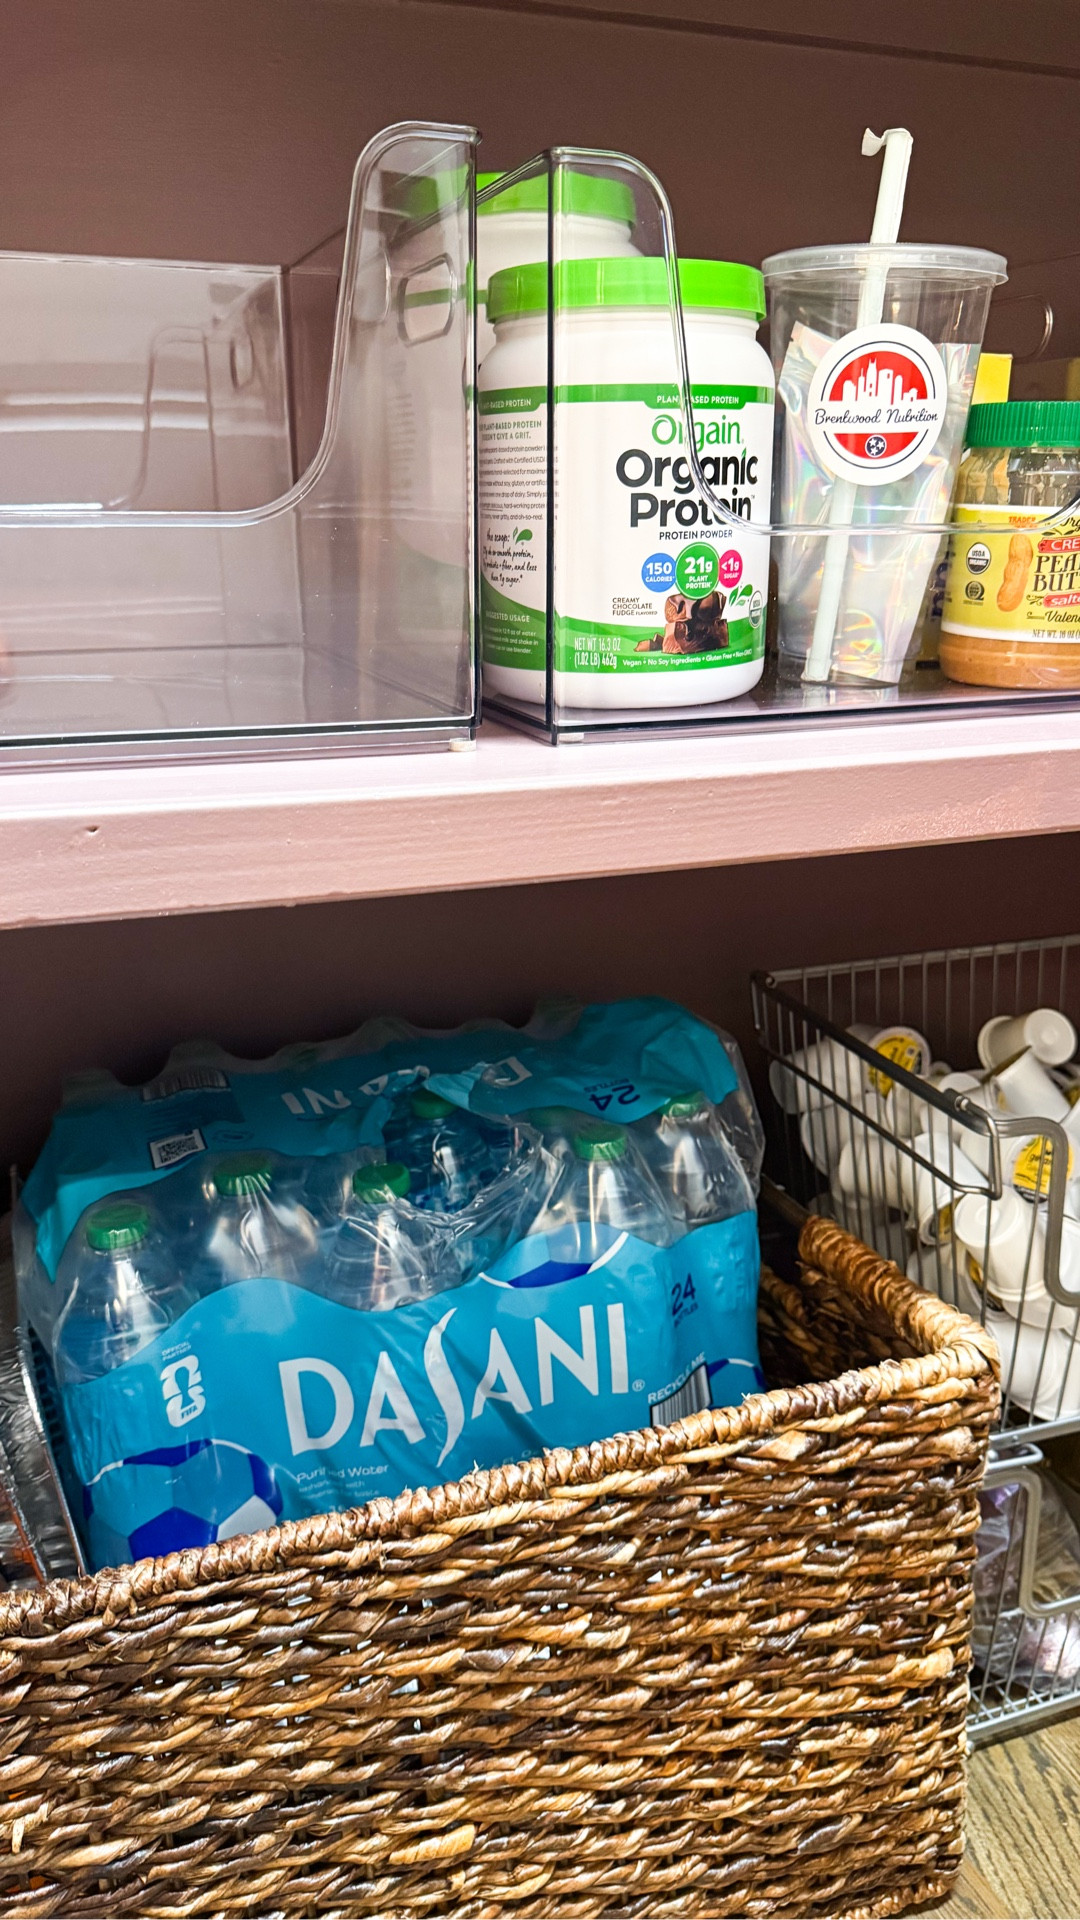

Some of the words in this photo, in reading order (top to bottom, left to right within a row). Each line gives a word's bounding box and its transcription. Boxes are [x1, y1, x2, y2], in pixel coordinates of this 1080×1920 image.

[505, 398, 531, 407] PROTEIN
[711, 396, 739, 404] PROTEIN
[814, 408, 881, 425] Brentwood
[886, 408, 939, 424] Nutrition
[513, 420, 541, 429] PROTEIN
[515, 431, 531, 439] GRIT.
[616, 448, 759, 494] Organic
[630, 487, 752, 528] Protein
[659, 531, 698, 540] PROTEIN
[700, 530, 732, 539] POWDER
[526, 562, 537, 571] less
[646, 562, 672, 575] 150
[684, 556, 713, 573] 21g
[721, 558, 740, 571] <1g
[509, 614, 530, 622] USAGE
[1032, 629, 1045, 638] NET
[574, 637, 586, 651] NET
[587, 637, 597, 652] WT
[599, 638, 611, 651] 16.3
[612, 638, 621, 651] OZ
[574, 651, 589, 668] (1.02
[590, 652, 601, 668] LB)
[602, 653, 617, 669] 462g
[623, 659, 642, 667] Vegan
[658, 658, 669, 666] Soy
[671, 656, 701, 665] Ingredients
[706, 654, 722, 662] Gluten
[589, 1086, 640, 1112] 24
[671, 1272, 696, 1317] 24
[690, 1351, 706, 1369] ME
[278, 1307, 629, 1468] DASANI
[348, 1463, 389, 1479] Water
